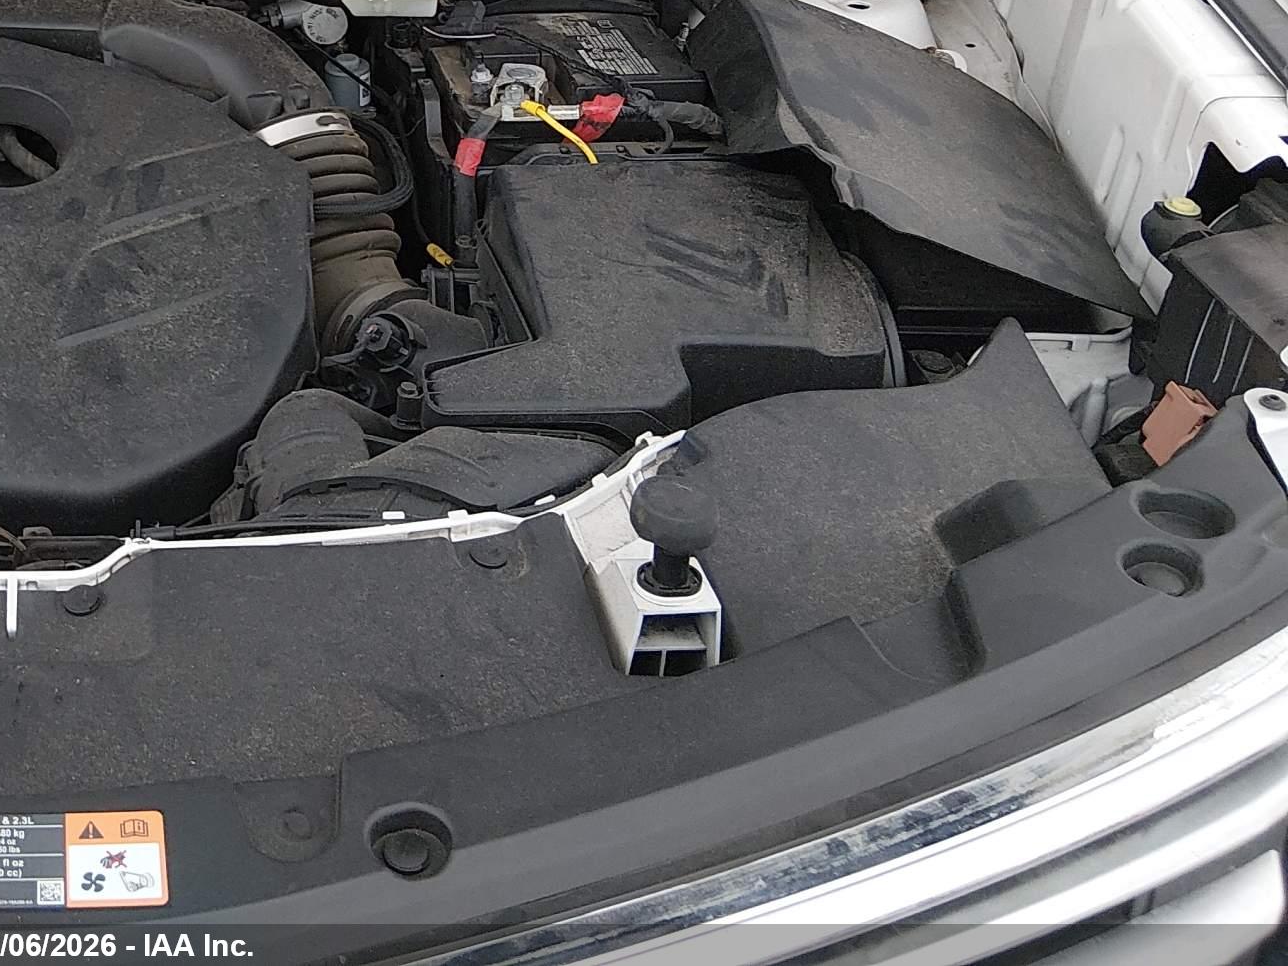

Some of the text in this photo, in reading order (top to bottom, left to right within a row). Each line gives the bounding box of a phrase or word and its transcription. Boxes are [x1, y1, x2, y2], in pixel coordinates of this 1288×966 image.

[12, 816, 34, 824] 2.3L
[14, 829, 24, 839] kg
[3, 859, 9, 867] fl
[7, 869, 22, 878] cc)
